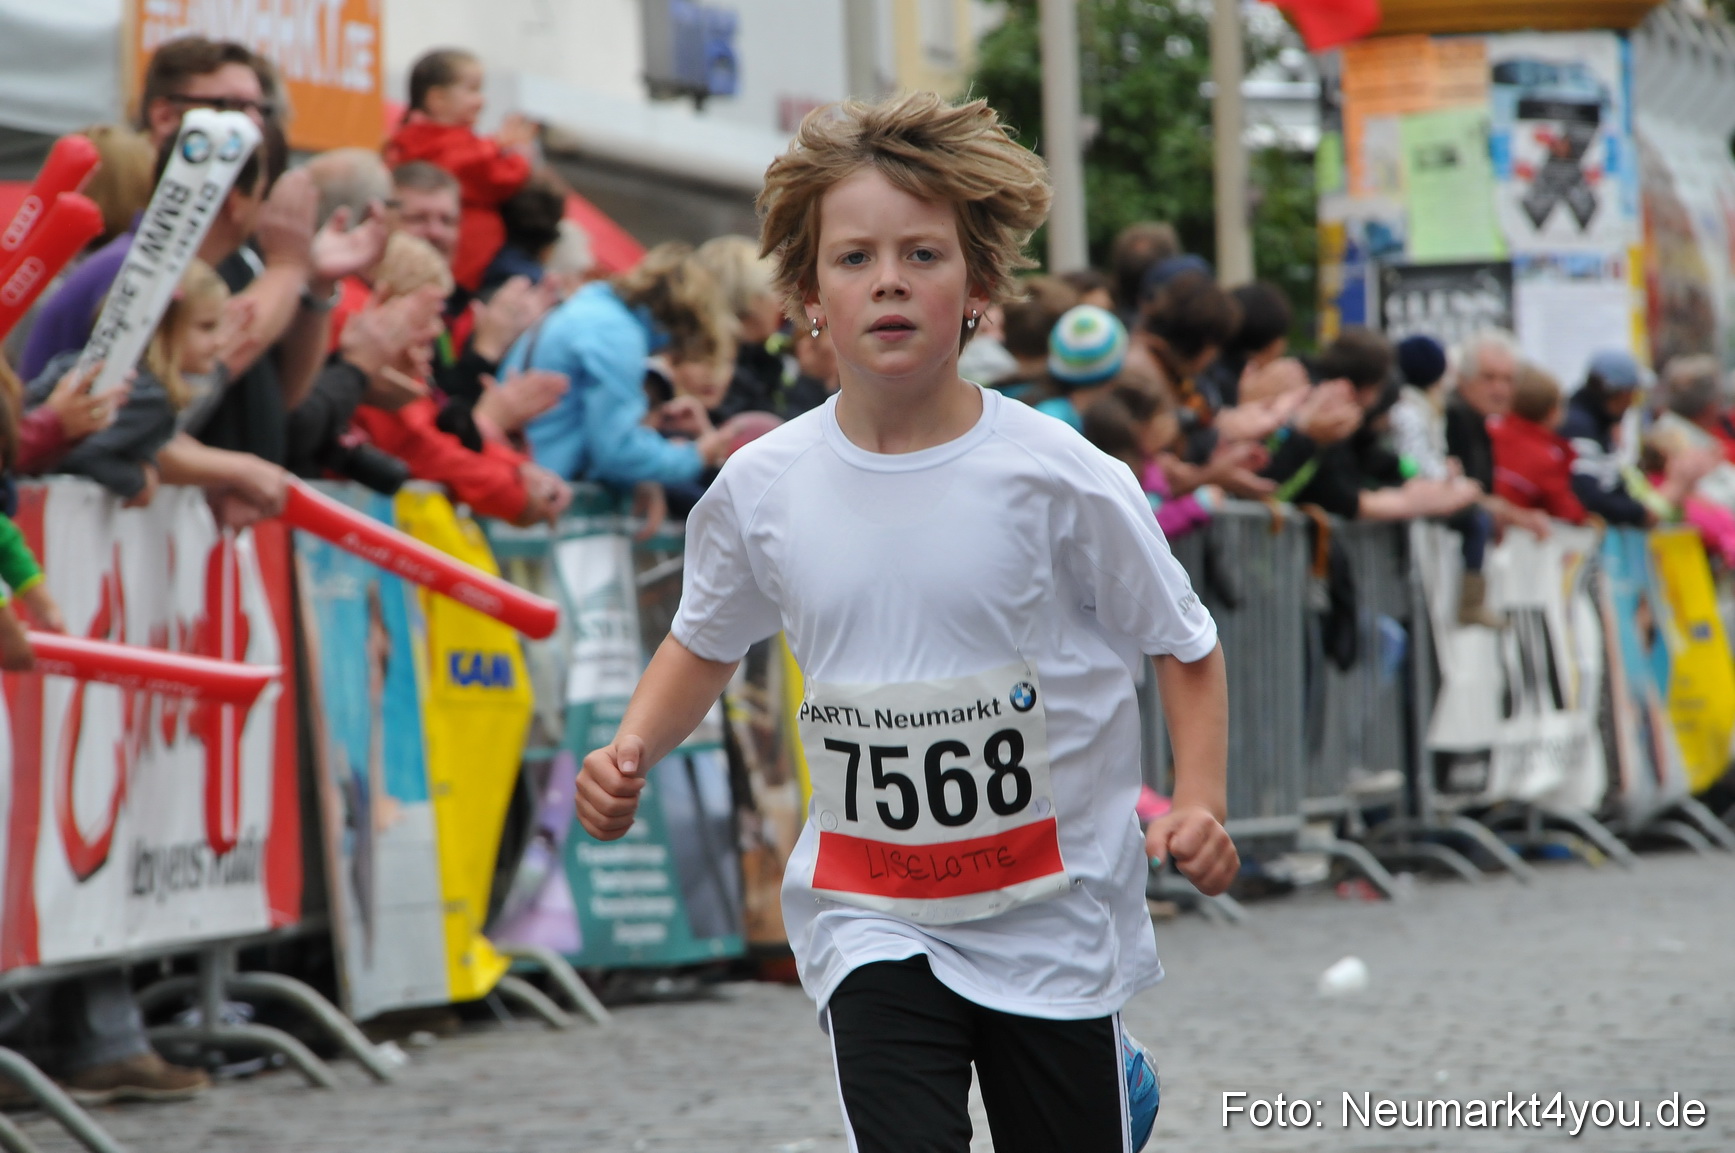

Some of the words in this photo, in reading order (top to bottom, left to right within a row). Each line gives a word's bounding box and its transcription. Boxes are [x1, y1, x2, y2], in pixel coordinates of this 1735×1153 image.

[139, 178, 190, 262] BMW
[799, 701, 871, 729] PARTL
[875, 697, 1002, 730] Neumarkt
[824, 728, 1033, 831] 7568
[865, 844, 1017, 881] LISELOTTE
